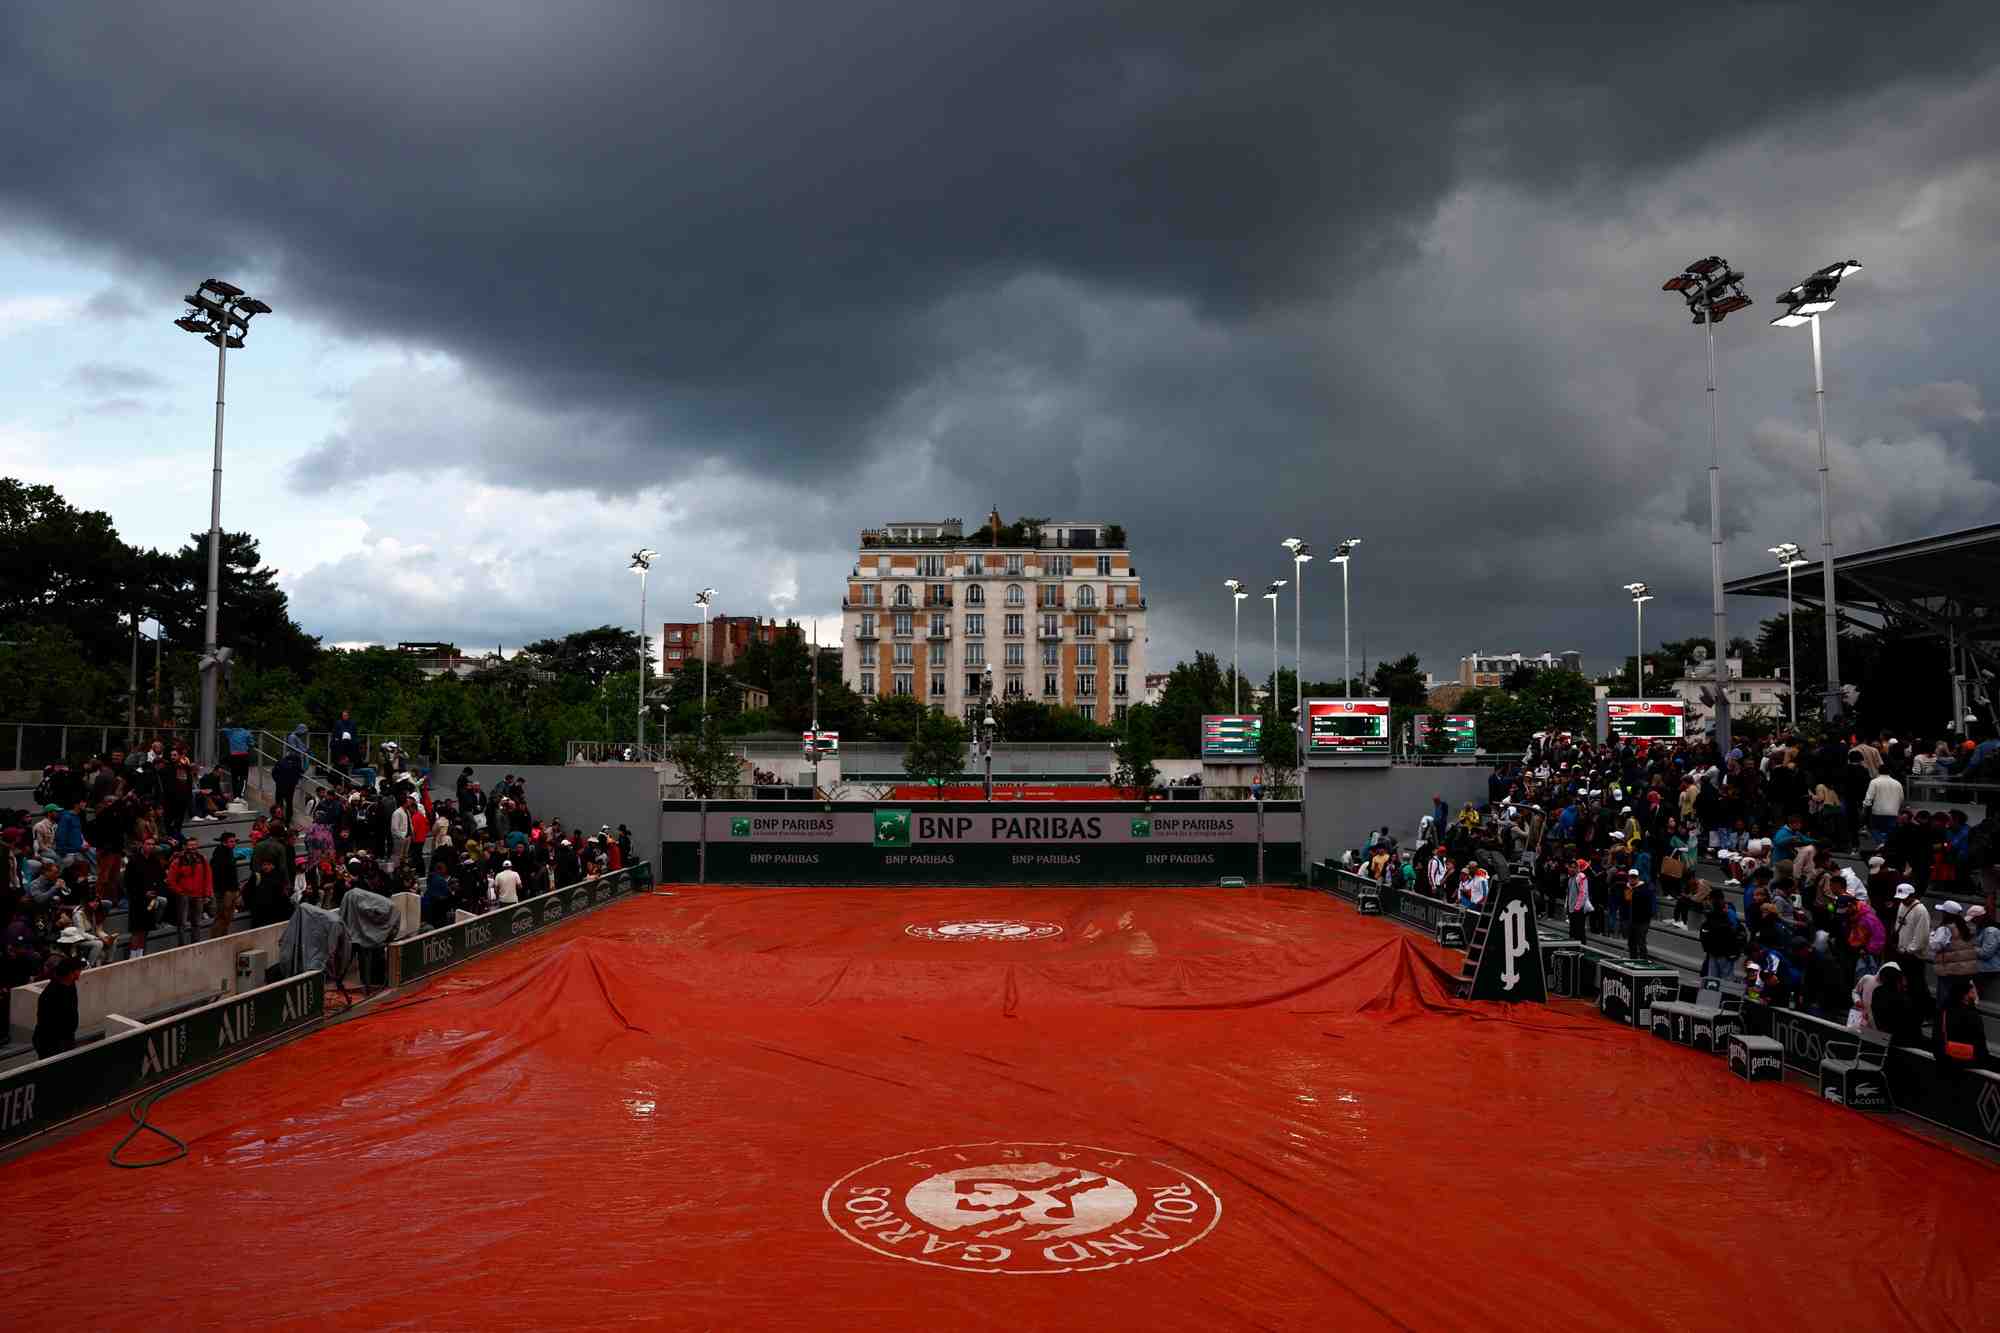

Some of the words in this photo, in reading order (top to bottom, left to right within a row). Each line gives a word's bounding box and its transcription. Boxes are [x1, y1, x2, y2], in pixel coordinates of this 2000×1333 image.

[753, 819, 779, 830] BNP
[782, 819, 834, 830] PARIBAS
[919, 817, 973, 839] BNP
[991, 817, 1101, 839] PARIBAS
[1154, 819, 1180, 830] BNP
[1182, 819, 1234, 830] PARIBAS
[750, 853, 773, 864] BNP
[775, 853, 820, 864] PARIBAS
[885, 854, 907, 864] BNP
[909, 854, 955, 864] PARIBAS
[1011, 854, 1033, 864] BNP
[1036, 854, 1081, 864] PARIBAS
[1145, 854, 1169, 864] BNP
[1170, 854, 1215, 864] PARIBAS
[845, 1186, 1012, 1263] GARROS
[1044, 1181, 1199, 1263] ROLAND
